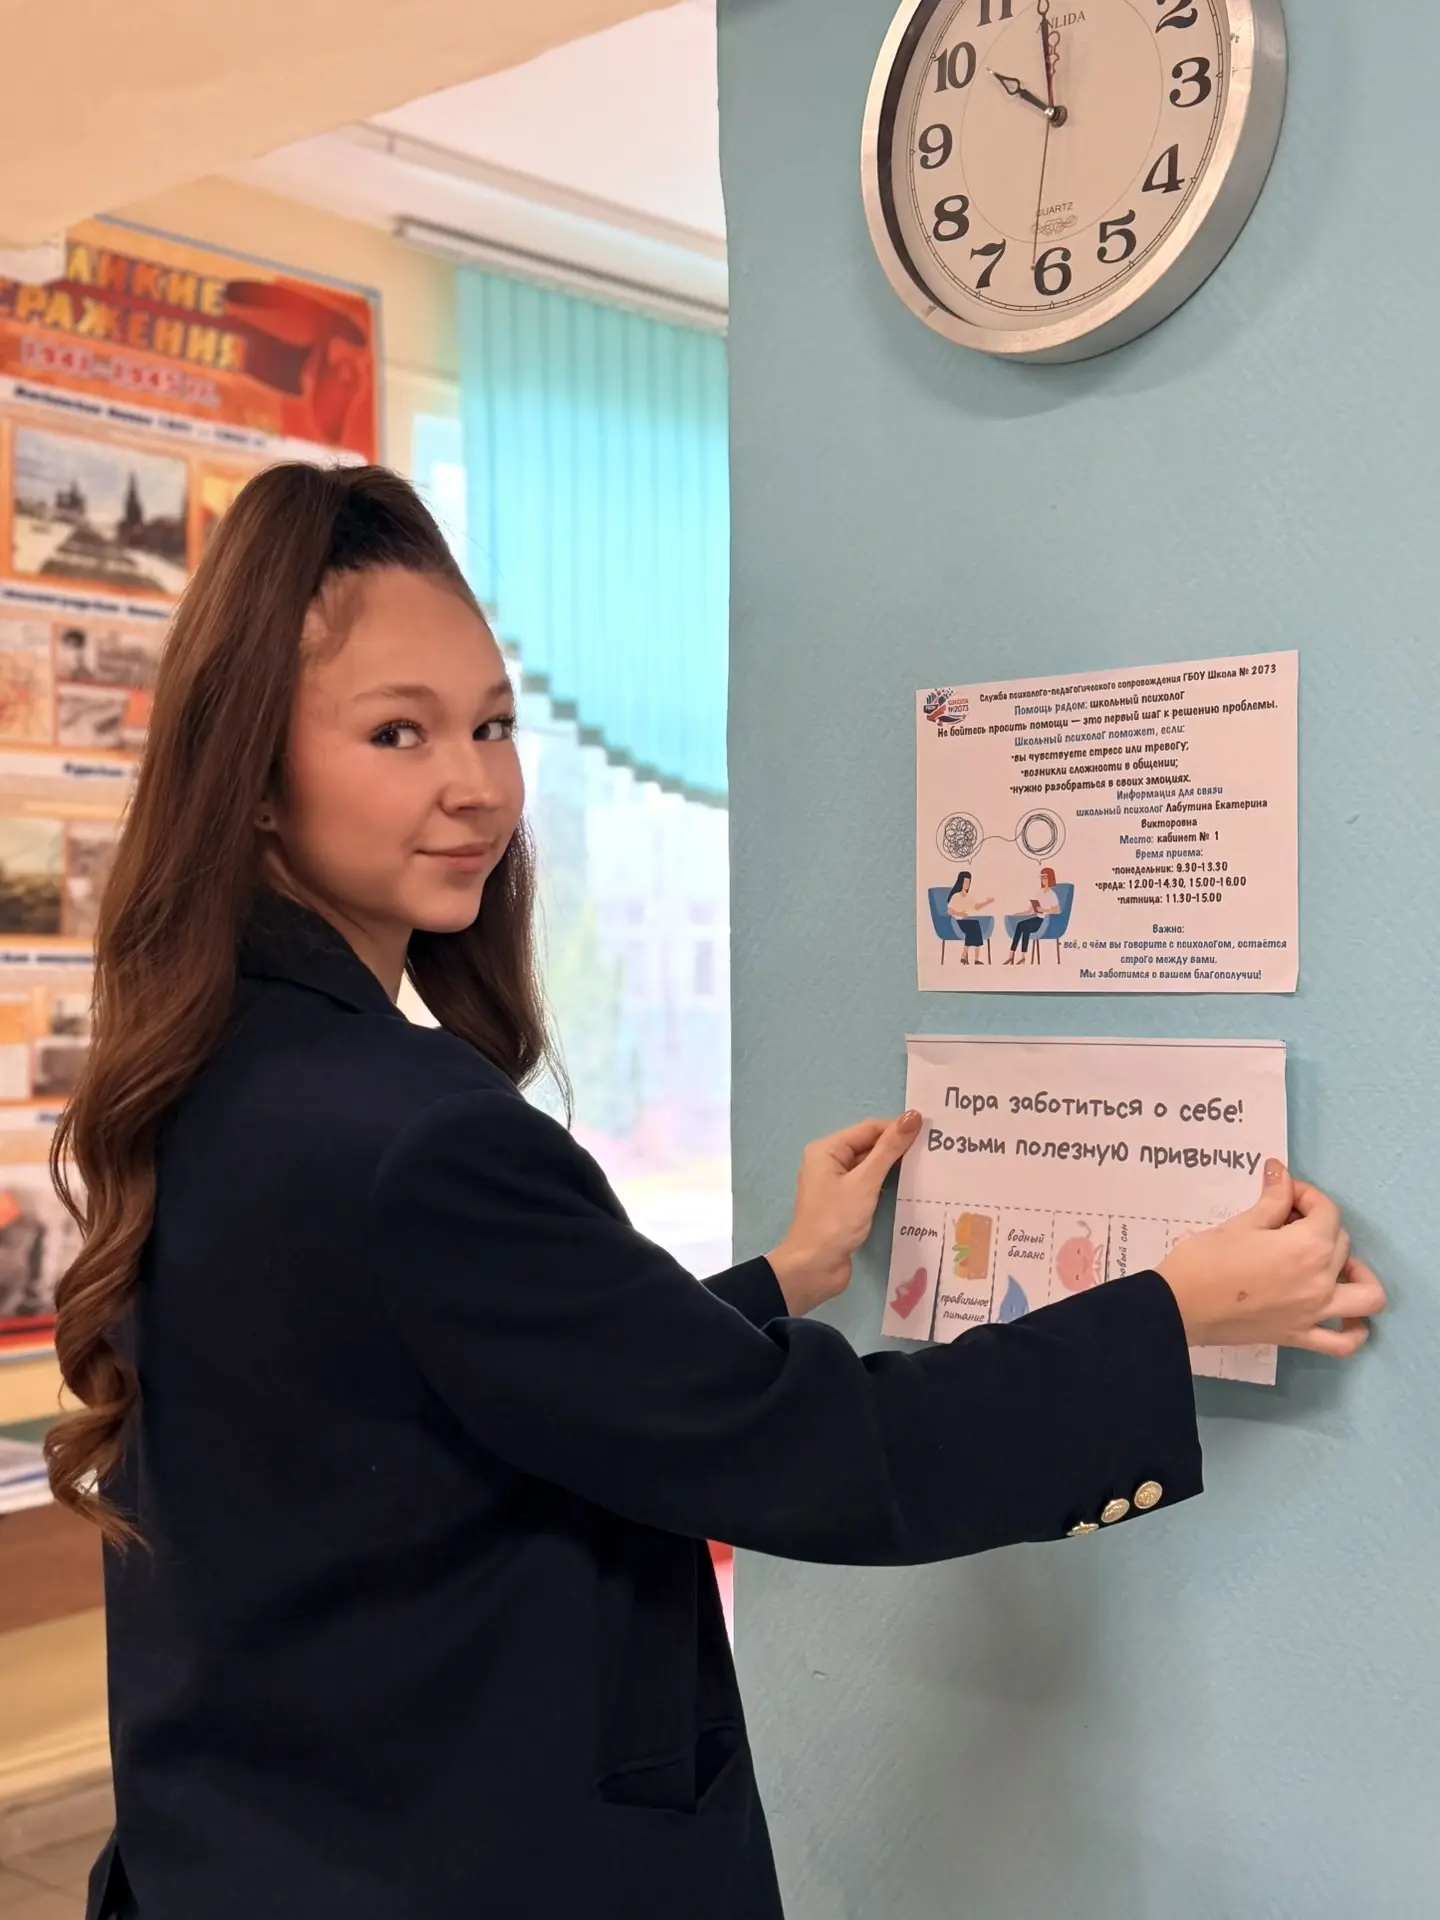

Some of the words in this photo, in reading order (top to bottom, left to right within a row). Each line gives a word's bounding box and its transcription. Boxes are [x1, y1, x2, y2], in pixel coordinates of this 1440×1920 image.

[1156, 0, 1198, 34] 2
[933, 41, 976, 93] 10
[1169, 56, 1212, 108] 3
[918, 123, 953, 169] 9
[1142, 143, 1185, 194] 4
[933, 194, 970, 242] 8
[1097, 209, 1137, 263] 5
[970, 238, 1006, 289] 7
[1034, 246, 1072, 296] 6
[980, 692, 1008, 703] Служба
[1009, 681, 1116, 699] психолого-педагогического
[1117, 675, 1181, 690] сопровождения
[1183, 671, 1206, 682] ГБОУ
[1207, 669, 1237, 680] Школа
[1239, 667, 1249, 677] №
[1251, 663, 1277, 676] 2073
[1014, 702, 1053, 716] Помощь
[1055, 702, 1089, 715] рядом:
[1090, 693, 1139, 708] школьный
[1141, 690, 1185, 704] психолог
[938, 728, 948, 738] Не
[950, 725, 986, 737] бойтесь
[988, 723, 1027, 735] просить
[1030, 719, 1069, 731] помощи
[1083, 715, 1102, 726] это
[1104, 710, 1139, 725] первый
[1142, 710, 1162, 720] шаг
[1164, 709, 1170, 718] к
[1172, 704, 1220, 719] решению
[1222, 699, 1278, 714] проблемы.
[1014, 733, 1062, 746] Школьный
[1064, 730, 1106, 743] психолог
[1108, 726, 1159, 739] поможет,
[1161, 724, 1185, 734] если:
[1013, 753, 1026, 763] вы
[1029, 749, 1087, 763] чувствуете
[1089, 747, 1123, 759] стресс
[1125, 744, 1142, 754] или
[1144, 741, 1189, 754] тревогу;
[1023, 765, 1066, 778] возникли
[1069, 762, 1122, 774] сложности
[1124, 761, 1130, 770] в
[1132, 757, 1179, 771] общении;
[1012, 783, 1042, 795] нужно
[1045, 778, 1105, 794] разобраться
[1108, 780, 1114, 788] в
[1116, 777, 1144, 788] своих
[1146, 773, 1191, 786] эмоциях.
[1117, 788, 1176, 801] Информация
[1179, 787, 1194, 798] для
[1197, 785, 1223, 796] связи
[1076, 805, 1122, 817] школьный
[1124, 804, 1164, 815] психолог
[1165, 801, 1213, 814] Лабутина
[1215, 799, 1268, 811] Екатерина
[1141, 818, 1198, 830] Викторовна
[1120, 834, 1154, 844] Место:
[1157, 832, 1197, 843] кабинет
[1199, 831, 1210, 841] №
[1215, 831, 1219, 841] 1
[1135, 849, 1164, 860] Время
[1166, 848, 1203, 859] приема:
[1114, 864, 1174, 876] понедельник:
[1176, 861, 1228, 873] 9.30-13.30
[1189, 876, 1246, 888] 15.00-16.00
[1166, 891, 1222, 904] 11.30-15.00
[1152, 923, 1185, 935] Важно:
[1082, 941, 1088, 949] о
[1090, 939, 1107, 949] чём
[1109, 940, 1121, 949] вы
[1124, 939, 1167, 951] говорите
[1169, 940, 1175, 949] с
[1177, 940, 1235, 950] психологом,
[1237, 938, 1287, 949] остаётся
[1120, 955, 1153, 965] строго
[1155, 955, 1187, 965] между
[1190, 955, 1217, 964] вами.
[1080, 968, 1096, 978] Мы
[1098, 968, 1149, 979] заботимся
[1152, 970, 1157, 979] о
[1160, 969, 1191, 979] вашем
[1194, 968, 1262, 980] благополучии!
[945, 1086, 998, 1116] Пора
[1008, 1090, 1143, 1118] заботиться
[1154, 1102, 1168, 1118] о
[1180, 1097, 1244, 1123] себе!
[927, 1128, 1006, 1156] Возьми
[1015, 1137, 1129, 1166] полезную
[1139, 1143, 1262, 1175] привычку
[900, 1225, 938, 1241] спорт
[1007, 1228, 1045, 1245] водный
[1007, 1245, 1045, 1260] баланс
[941, 1292, 989, 1308] правильное
[943, 1309, 985, 1323] питание
